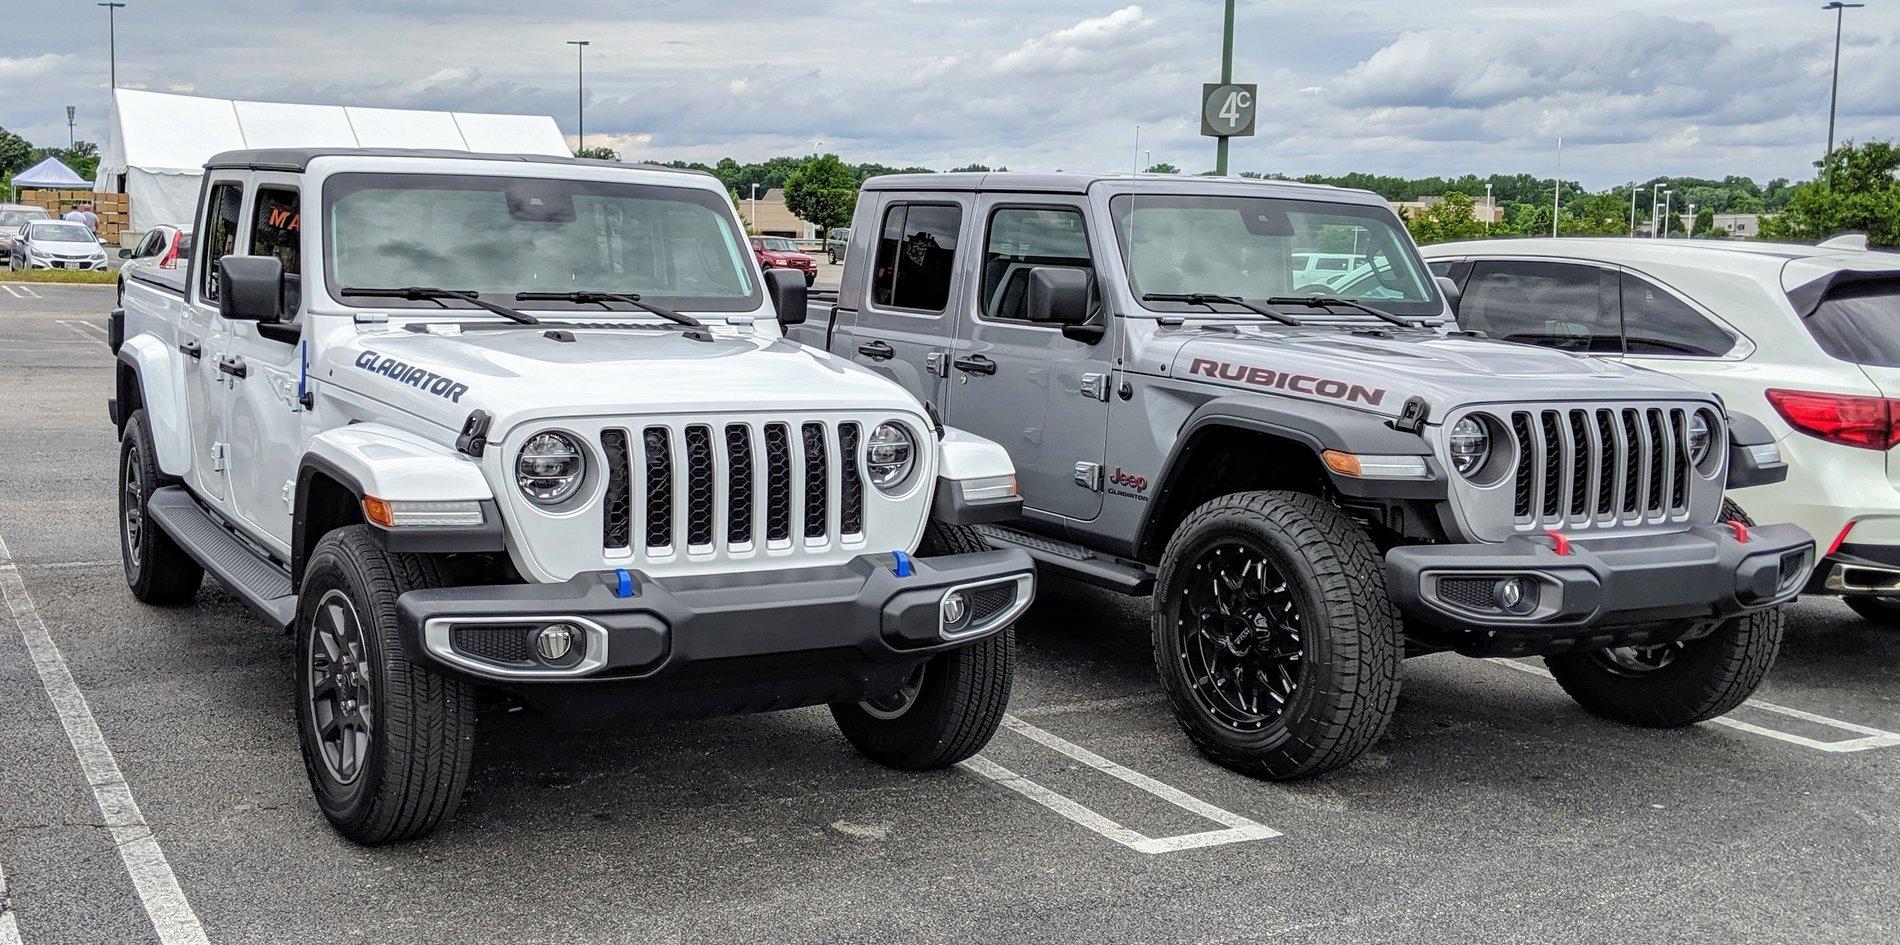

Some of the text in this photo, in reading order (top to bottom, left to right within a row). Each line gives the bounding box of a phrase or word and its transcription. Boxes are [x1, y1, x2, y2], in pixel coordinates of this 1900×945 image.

[355, 350, 469, 404] GLADIATOR
[1189, 357, 1386, 407] RUBICON
[1108, 488, 1149, 501] GLADIATOR
[1110, 467, 1148, 493] Jeep
